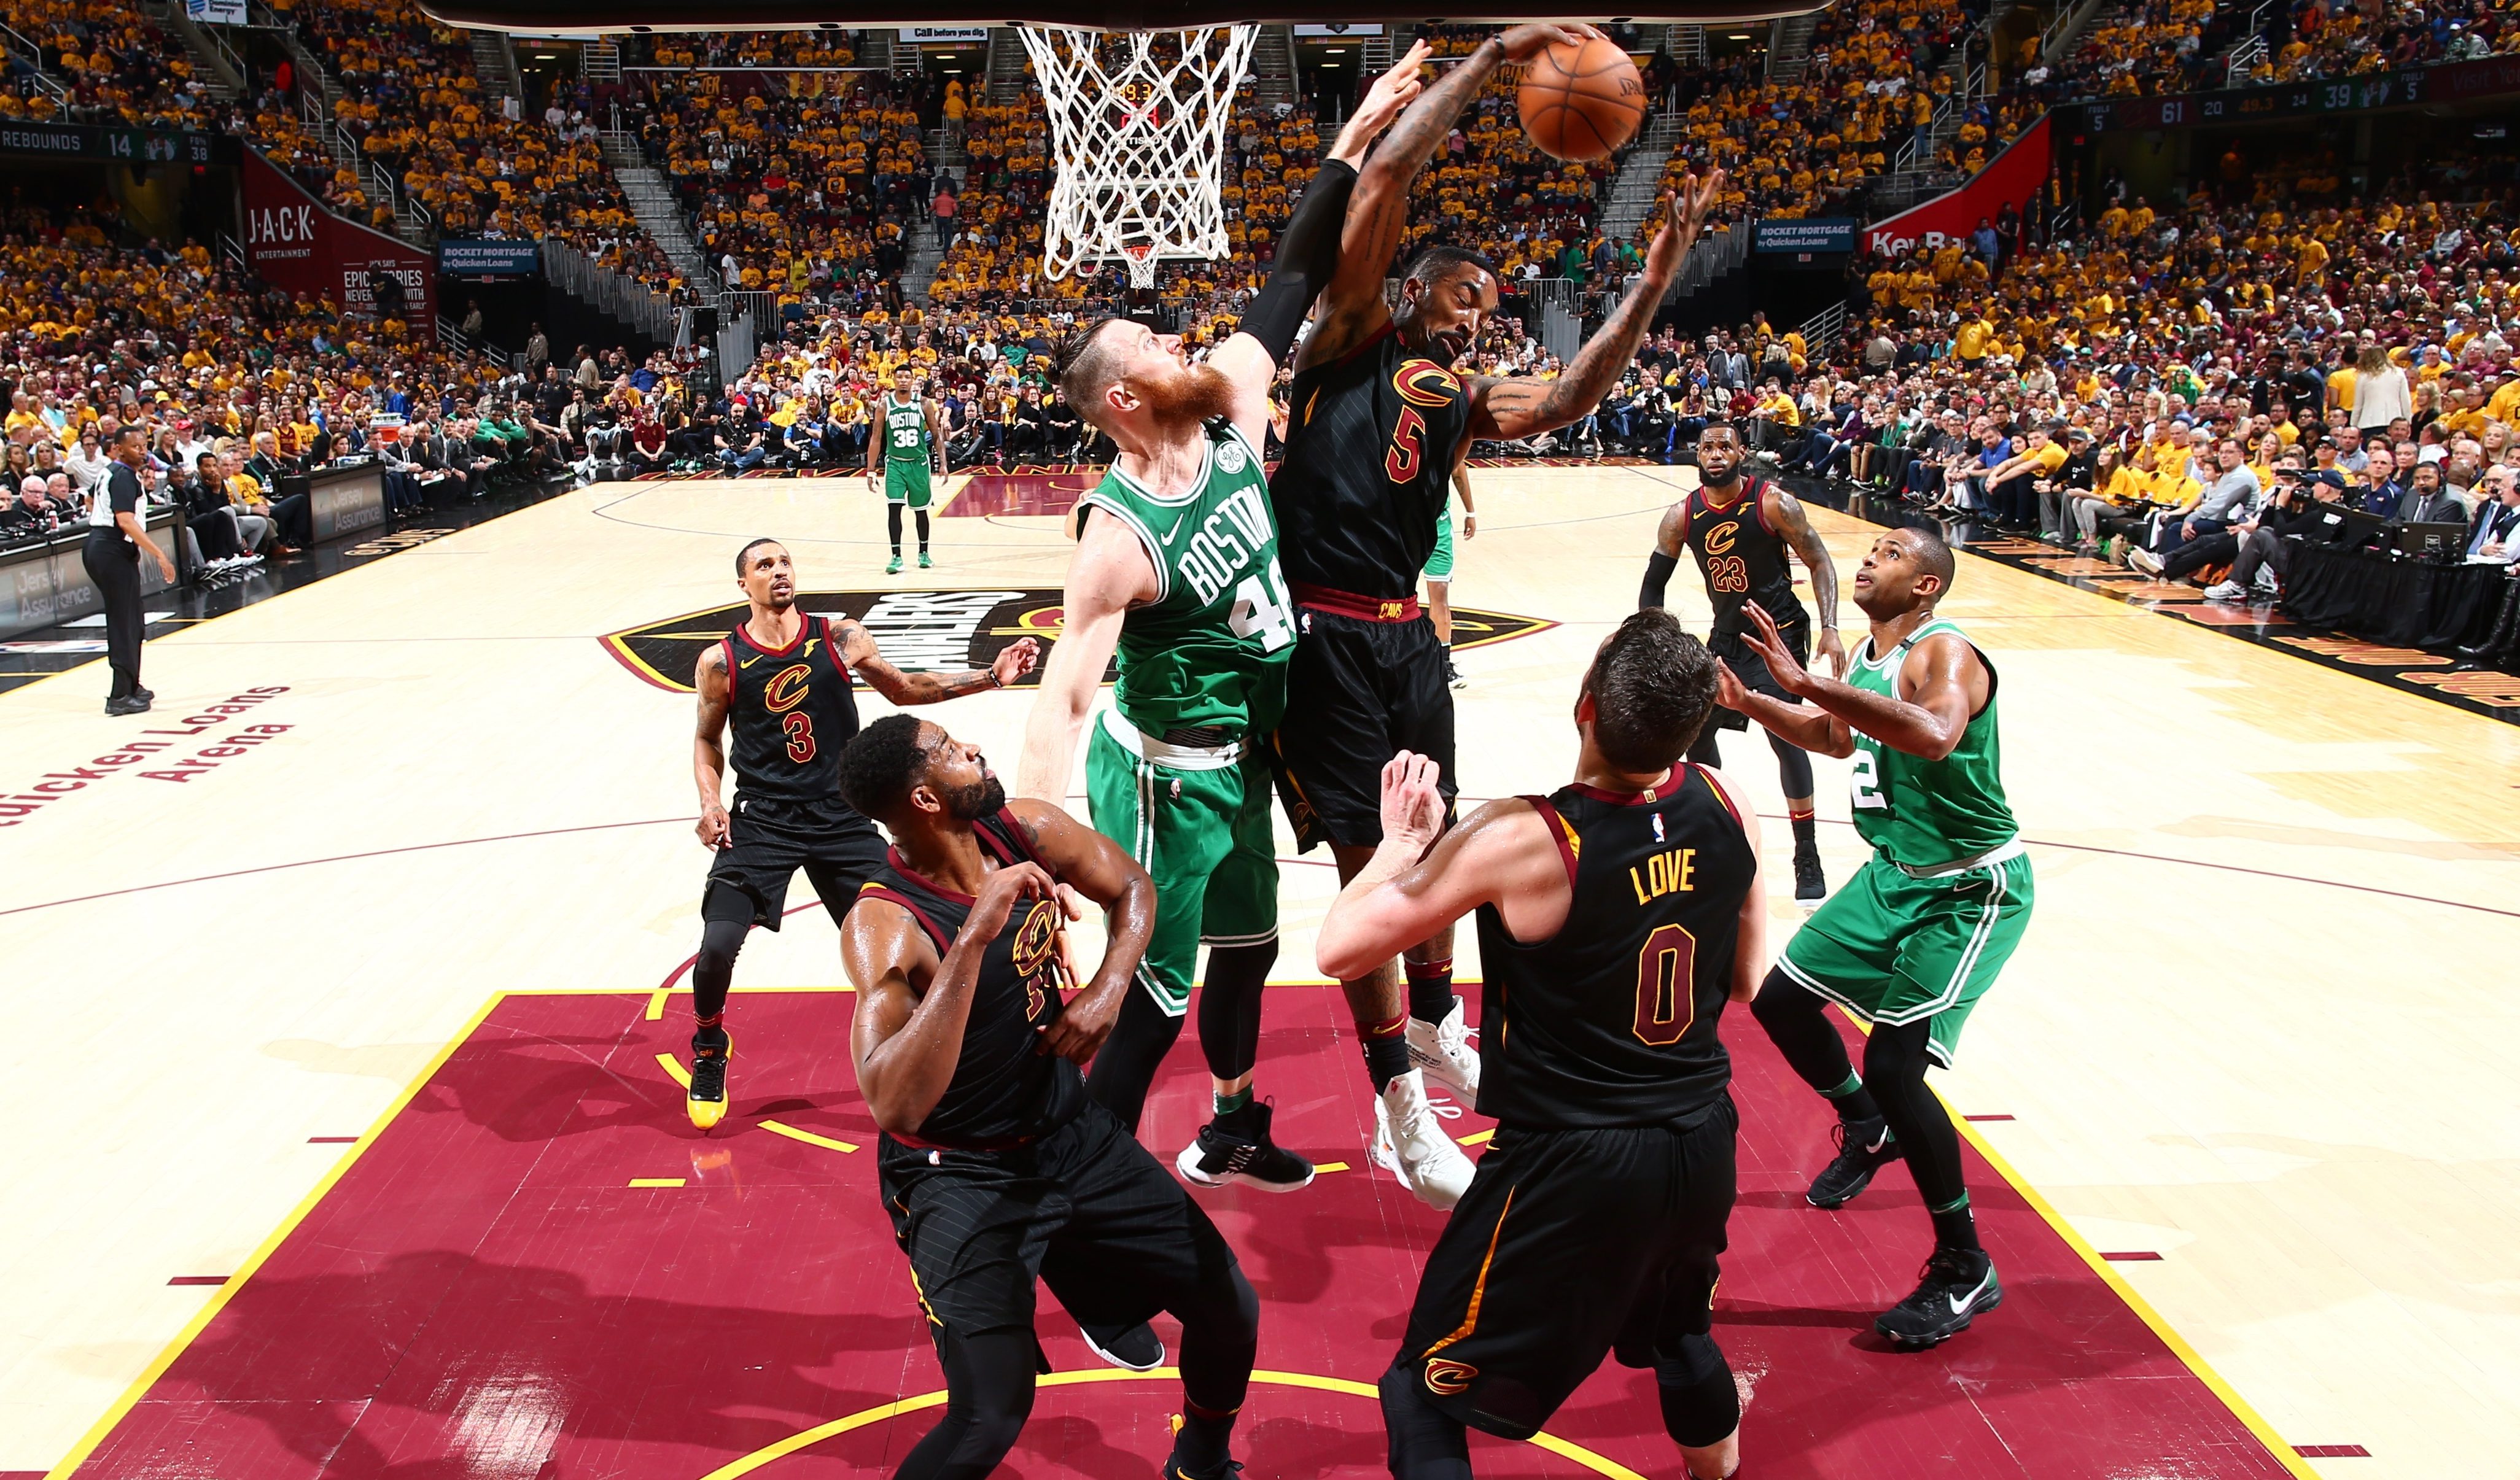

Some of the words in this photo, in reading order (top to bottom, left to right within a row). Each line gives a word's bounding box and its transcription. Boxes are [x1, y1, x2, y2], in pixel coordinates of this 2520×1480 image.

[915, 28, 932, 37] Call
[973, 28, 985, 37] dig.
[2401, 72, 2424, 82] FOULS
[2498, 64, 2520, 86] Yo
[2292, 94, 2308, 107] 24
[2325, 84, 2351, 108] 39
[2407, 83, 2416, 100] 5
[2089, 105, 2110, 114] FOULS
[2162, 101, 2184, 123] 61
[2239, 98, 2272, 113] 49.3
[2094, 115, 2103, 131] 5
[2, 130, 80, 150] REBOUNDS
[110, 133, 132, 157] 14
[192, 147, 208, 160] 38
[1760, 227, 1797, 236] ROCKET
[1799, 226, 1852, 234] MORTGAGE
[1767, 237, 1801, 247] Quicken
[1802, 237, 1829, 246] Loans
[256, 249, 311, 260] ENTERTAINMENT
[445, 248, 481, 257] ROCKET
[483, 248, 534, 257] MORTGAGE
[452, 258, 486, 268] Quicken
[488, 258, 513, 267] Loans
[344, 271, 370, 288] EPIC
[345, 289, 373, 302] NEVER
[889, 411, 920, 429] BOSTON
[893, 428, 919, 448] 36
[1385, 404, 1426, 484] 5
[333, 487, 363, 508] Jersey
[335, 505, 380, 532] Assurance
[344, 528, 456, 556] @CAVS
[1178, 482, 1274, 608] BOSTON
[1707, 556, 1748, 592] 23
[21, 585, 91, 621] Assurance
[1378, 602, 1403, 620] CAVS
[782, 710, 816, 764] 3
[0, 742, 174, 827] uicken
[139, 686, 291, 735] Loans
[136, 724, 296, 783] Arena
[1629, 848, 1696, 906] LOVE
[1632, 923, 1696, 1046] 0
